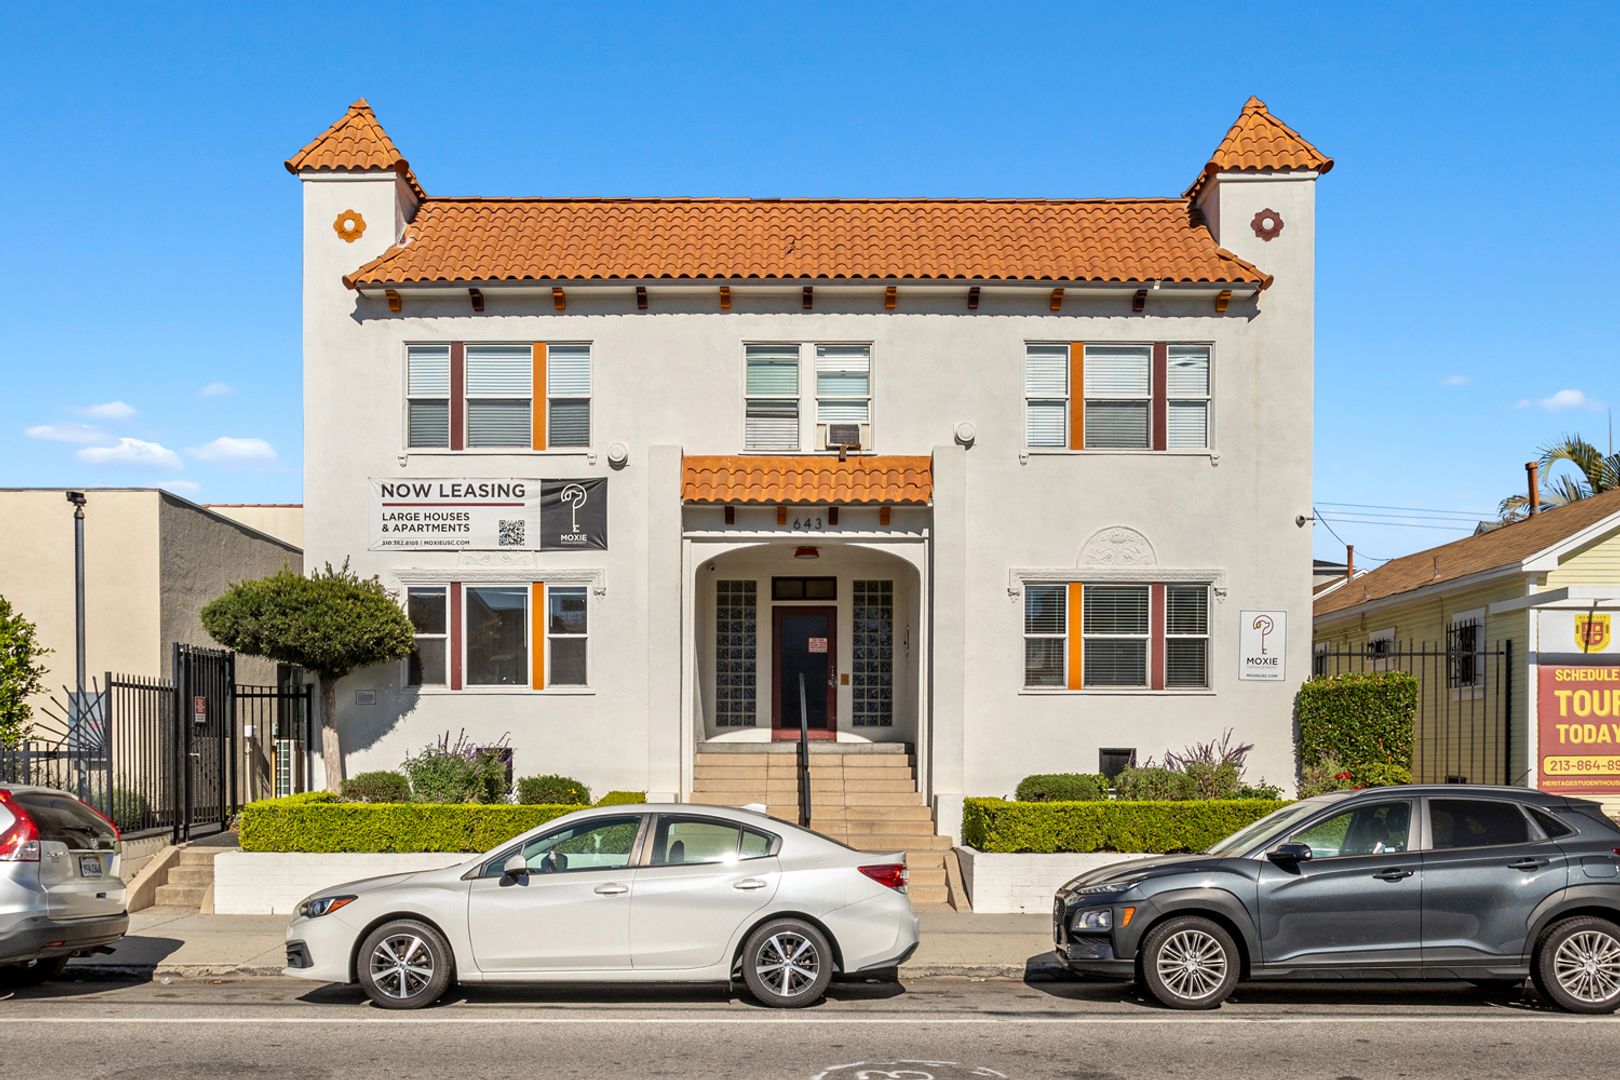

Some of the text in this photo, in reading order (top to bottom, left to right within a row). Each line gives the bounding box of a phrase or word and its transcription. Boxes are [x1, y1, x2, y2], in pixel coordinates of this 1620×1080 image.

[381, 483, 525, 498] NOW LEASING
[382, 512, 470, 521] LARGE HOUSES
[382, 523, 470, 532] & APARTMENTS
[793, 517, 822, 530] 643
[1246, 657, 1278, 666] MOXIE
[1555, 669, 1619, 681] SCHEDULE
